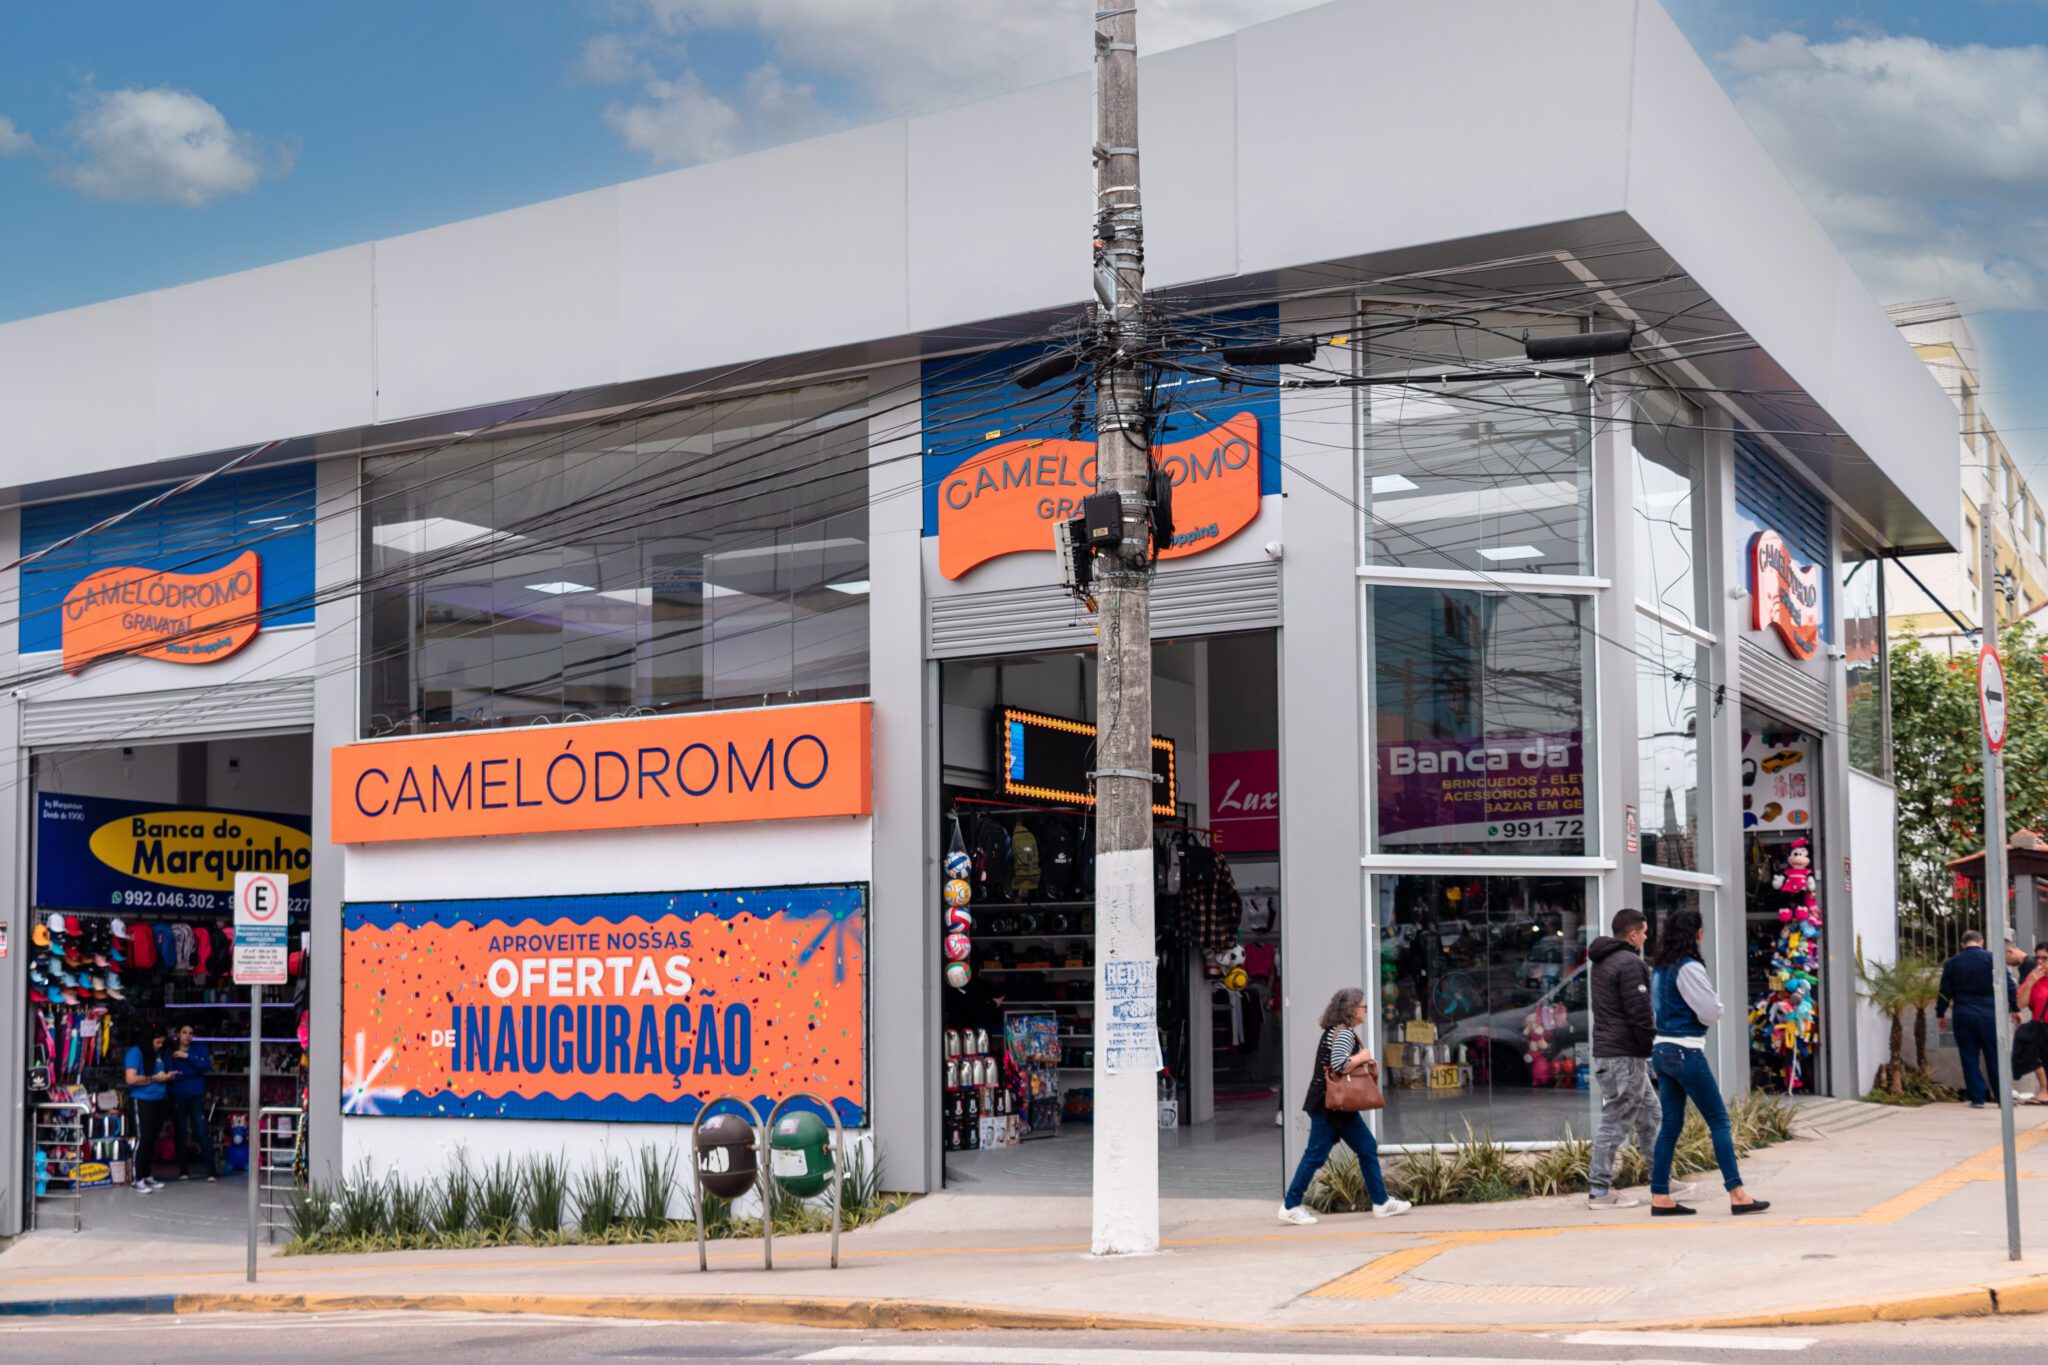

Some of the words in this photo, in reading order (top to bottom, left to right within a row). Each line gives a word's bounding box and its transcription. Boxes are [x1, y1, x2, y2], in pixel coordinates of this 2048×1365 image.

[945, 438, 1249, 509] CAMELOMO
[66, 570, 252, 620] CAMELÓDROMO
[122, 613, 192, 635] GRAVATAÍ
[1389, 747, 1508, 776] Banca
[1520, 738, 1569, 769] da
[355, 734, 828, 817] CAMELÓDROMO
[1442, 776, 1537, 789] BRINQUEDOS
[1217, 779, 1278, 812] Lux
[1444, 787, 1537, 802] ACESSÓRIOS
[1541, 788, 1581, 797] PARA
[1485, 802, 1533, 812] BAZAR
[1537, 801, 1558, 811] EM
[132, 818, 204, 838] Banca
[213, 819, 241, 838] do
[1503, 820, 1583, 838] 991.72
[132, 836, 311, 881] Marquinho
[125, 890, 214, 909] 992.046.302
[255, 886, 268, 911] E
[488, 933, 600, 953] APROVEITE
[607, 931, 692, 950] NOSSAS
[487, 955, 693, 998] OFERTAS
[431, 1030, 456, 1048] DE
[452, 989, 751, 1089] INAUGURAÇÃO
